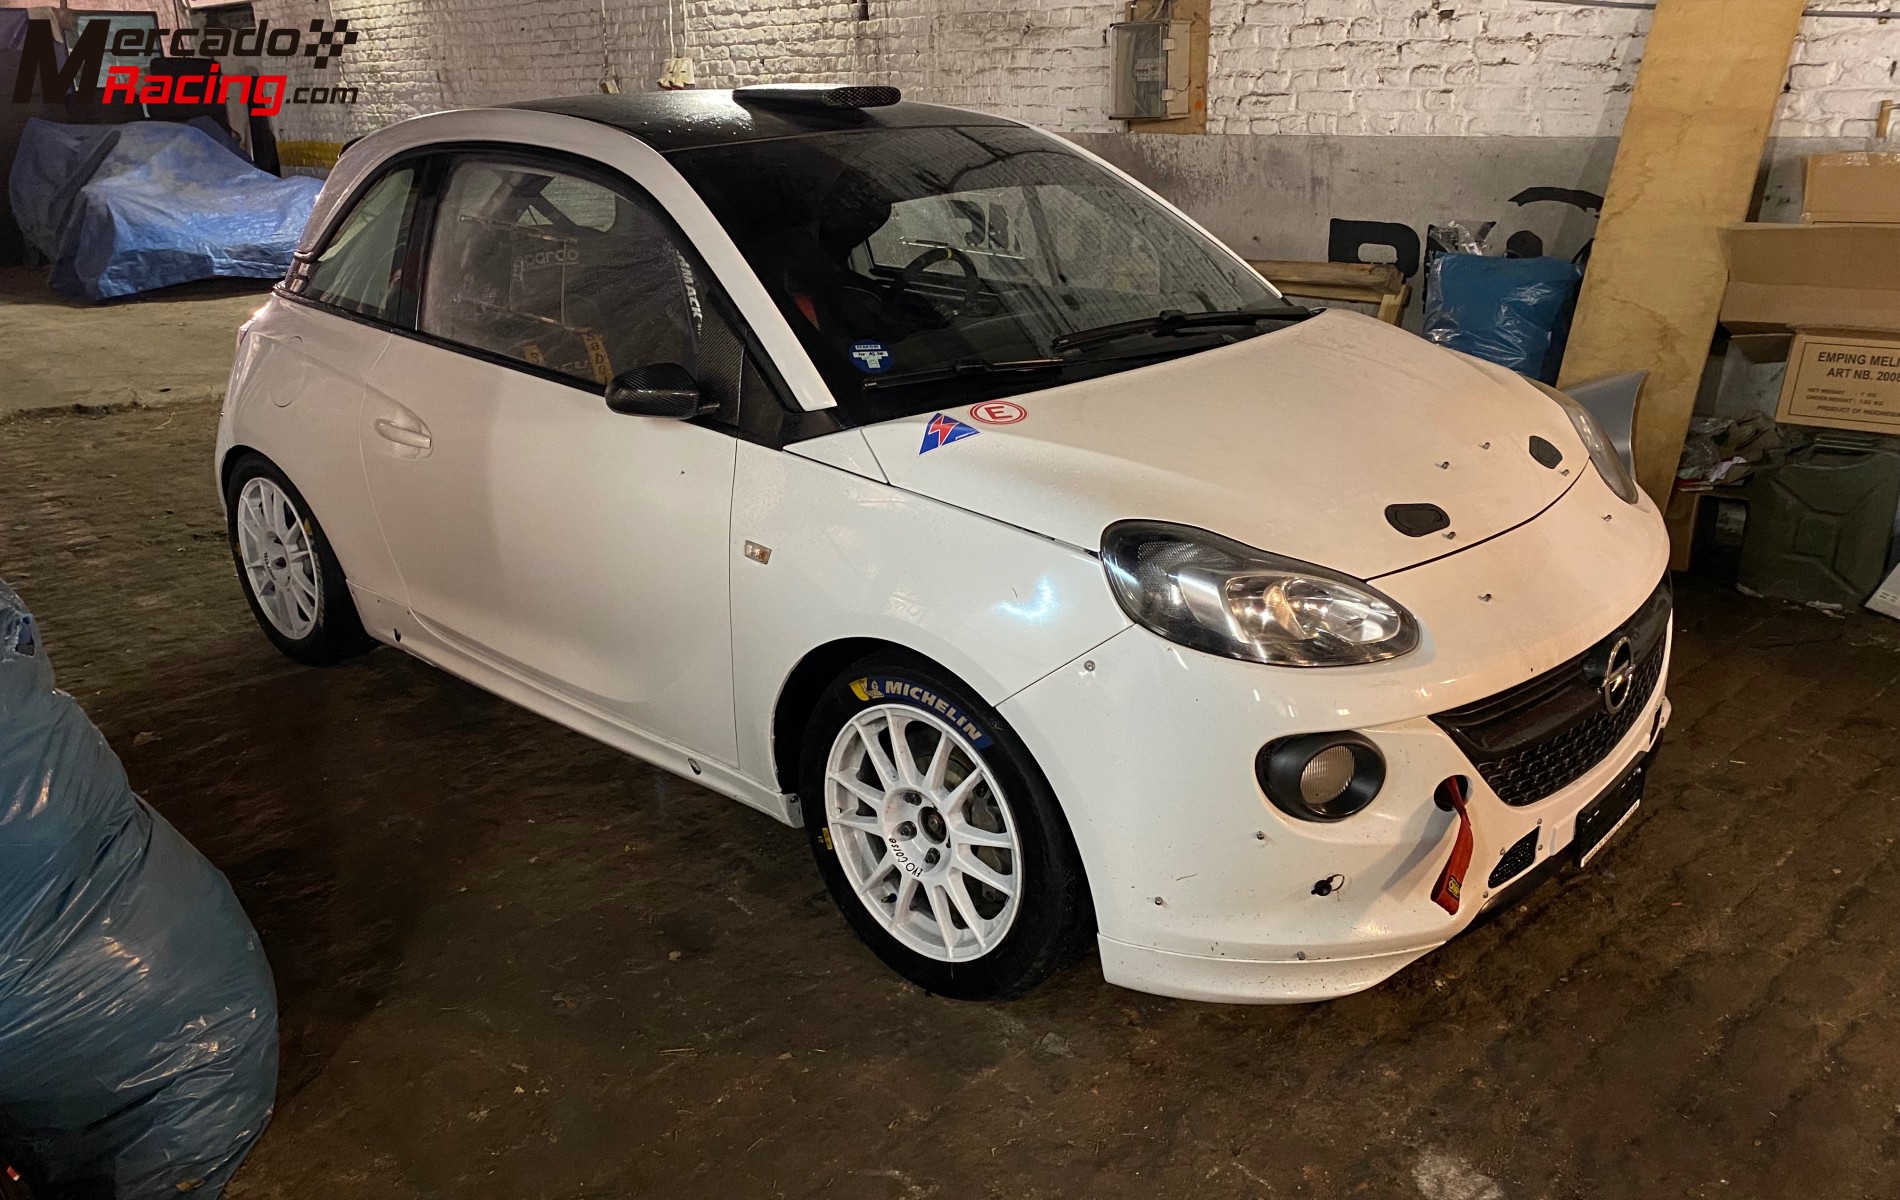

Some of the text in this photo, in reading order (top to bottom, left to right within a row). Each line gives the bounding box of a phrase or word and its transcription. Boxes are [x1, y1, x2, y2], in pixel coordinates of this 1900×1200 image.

[1817, 352, 1867, 365] EMPING
[1827, 368, 1851, 378] ART
[1853, 370, 1873, 380] NB.
[985, 406, 1013, 420] E
[1817, 405, 1850, 413] PRODUCT
[885, 680, 982, 741] MICHELIN
